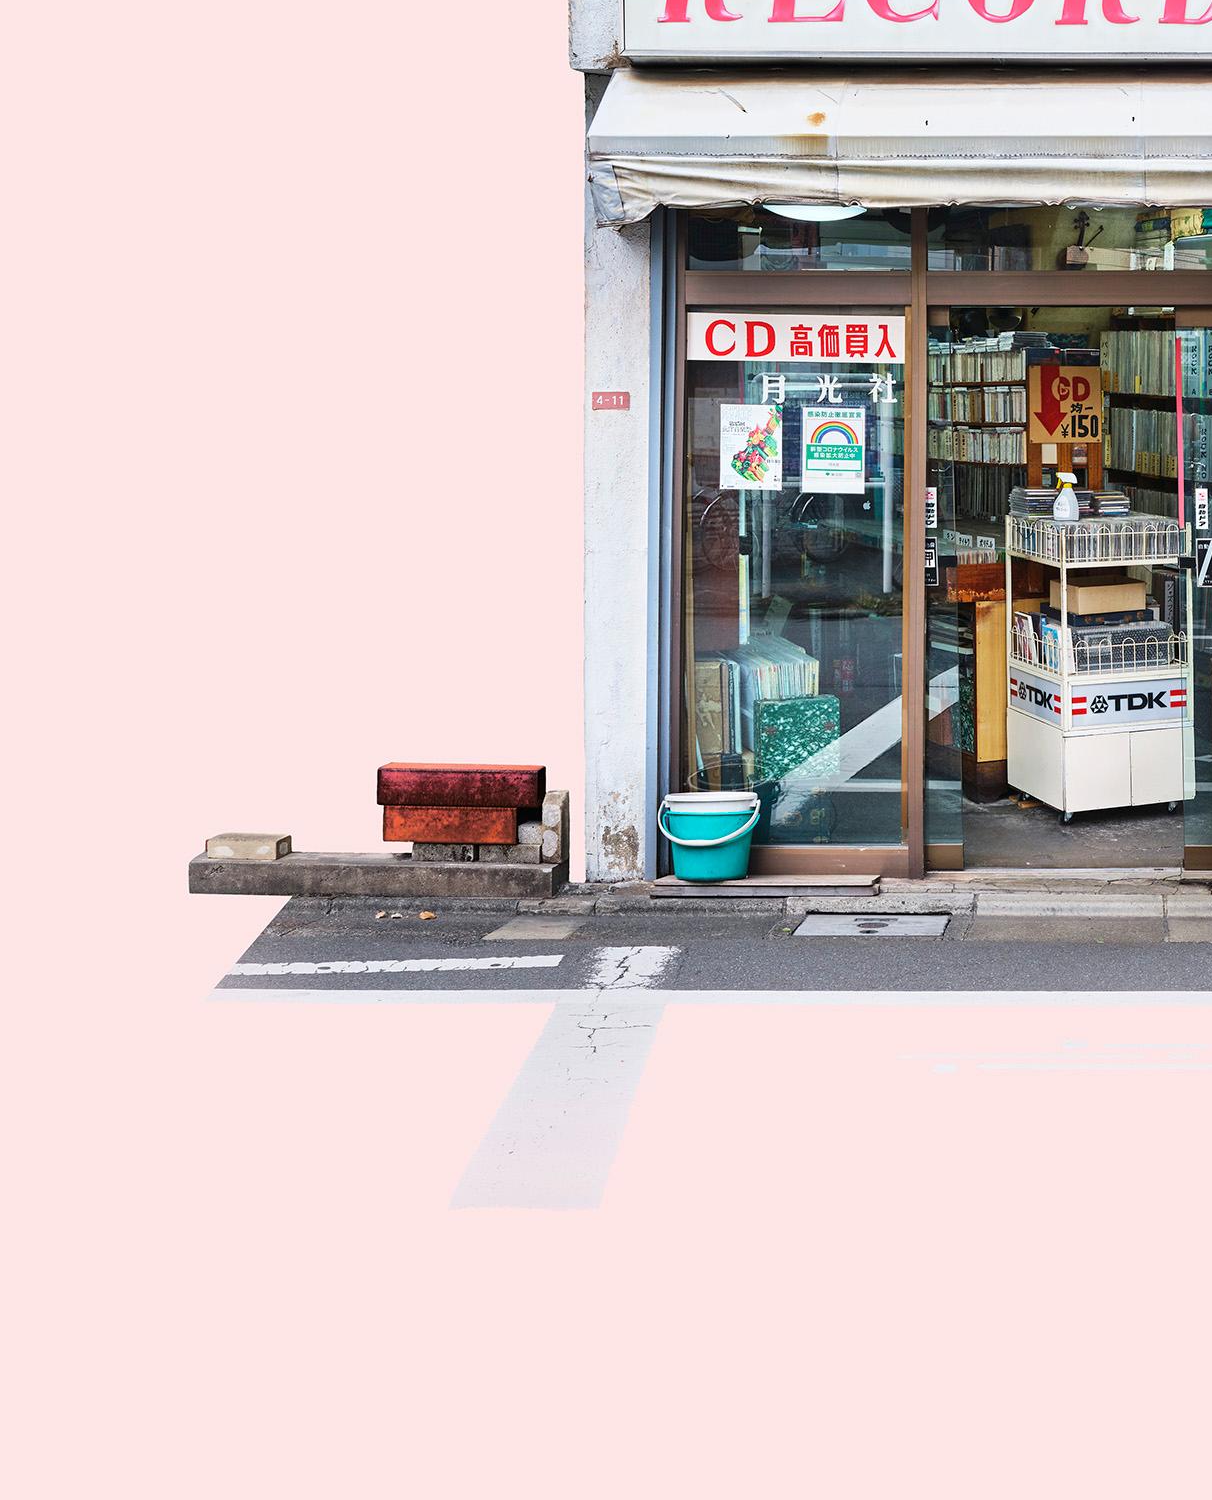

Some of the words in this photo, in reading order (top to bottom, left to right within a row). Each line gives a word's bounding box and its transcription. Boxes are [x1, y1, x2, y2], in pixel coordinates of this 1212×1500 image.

[705, 319, 776, 357] CD
[789, 324, 897, 358] 高価買入
[596, 395, 624, 406] 4-11
[760, 373, 898, 404] 月光社
[1060, 414, 1099, 438] ¥150
[1025, 685, 1054, 711] TDK
[1107, 691, 1168, 712] TDK
